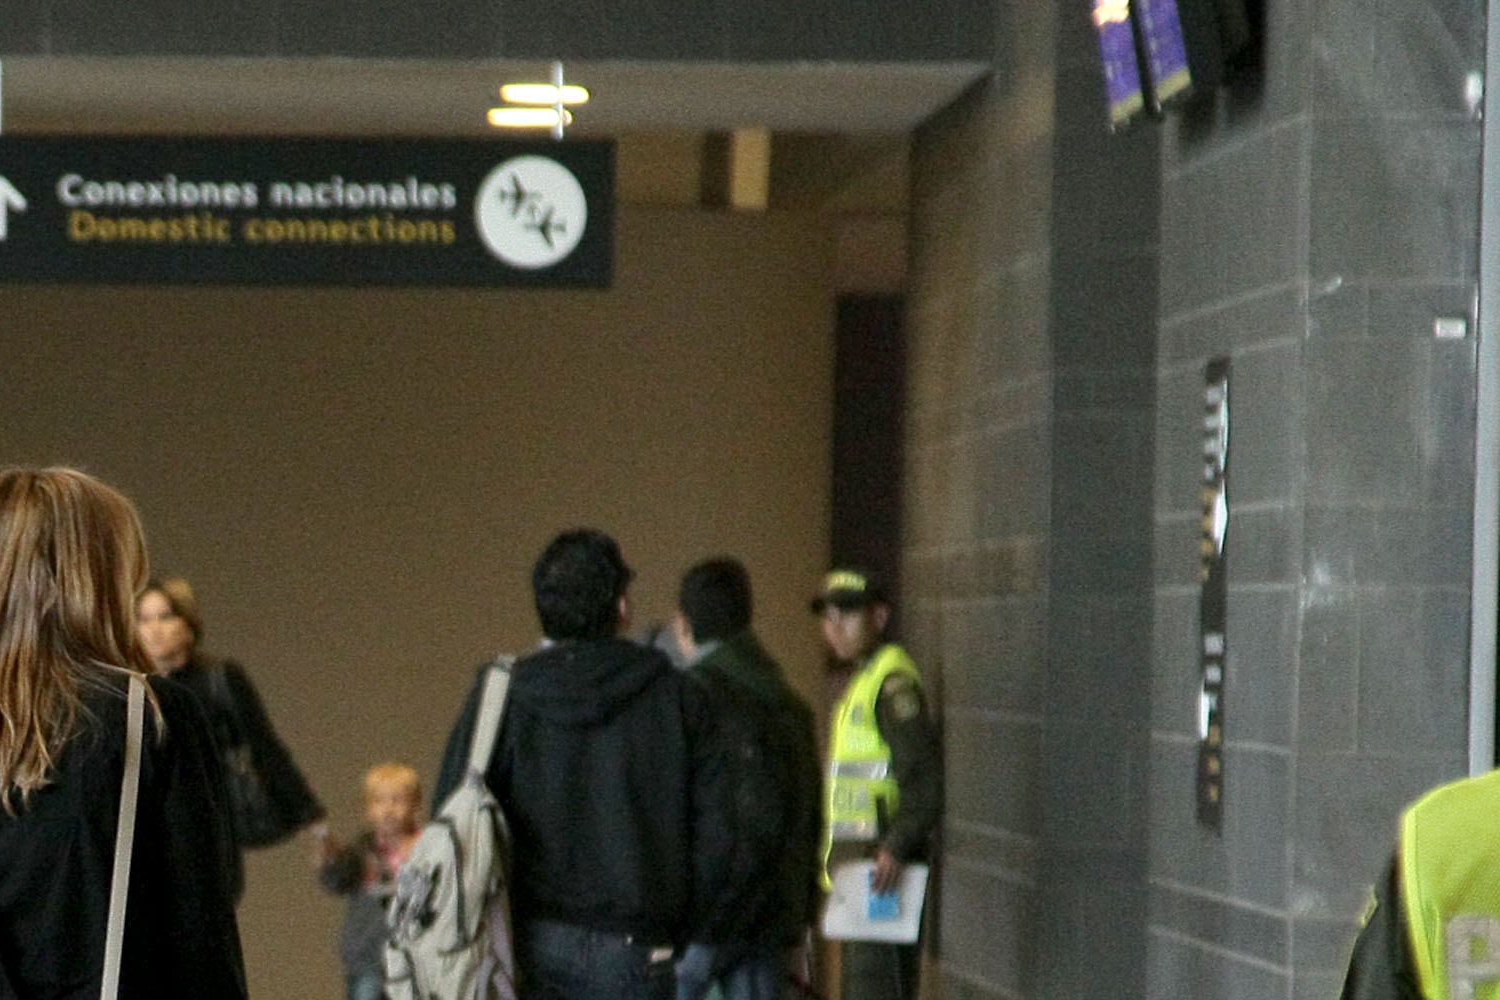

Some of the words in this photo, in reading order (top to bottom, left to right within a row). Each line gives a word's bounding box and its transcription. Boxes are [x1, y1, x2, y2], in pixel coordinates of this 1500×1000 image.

[57, 173, 258, 208] Conexiones
[270, 174, 457, 209] nacionales
[70, 211, 231, 241] Domestic
[243, 211, 456, 243] connections
